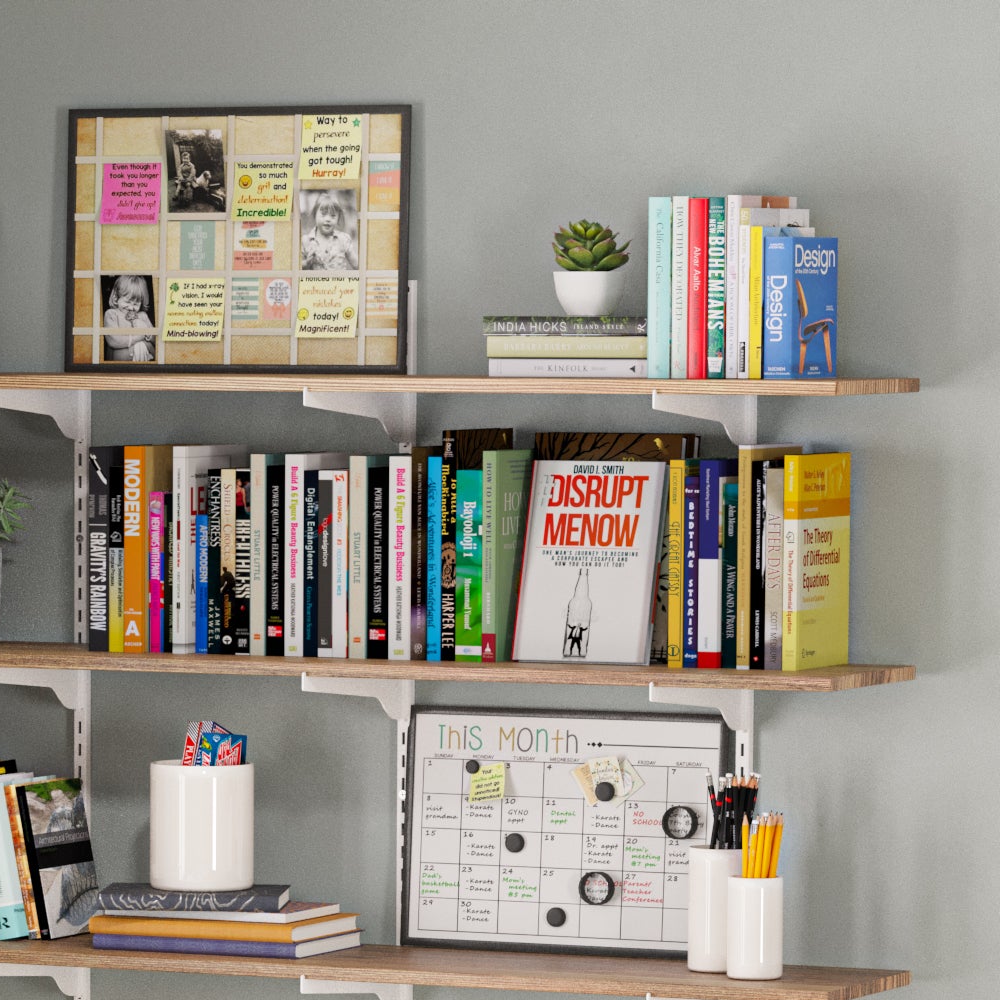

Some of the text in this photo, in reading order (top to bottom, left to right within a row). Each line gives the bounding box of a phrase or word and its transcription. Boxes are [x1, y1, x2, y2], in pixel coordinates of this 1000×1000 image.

[317, 115, 348, 126] Way to
[313, 130, 350, 143] persevere
[303, 145, 323, 153] when
[340, 145, 361, 153] going
[308, 156, 353, 166] got tough!
[130, 163, 148, 171] though
[312, 169, 346, 178] Hurray!
[257, 182, 271, 194] grit
[236, 208, 287, 217] Incredible!
[708, 218, 716, 234] NEW
[716, 220, 724, 234] THE
[693, 246, 702, 291] Alvar Aalto
[794, 244, 836, 275] Design
[708, 236, 725, 330] BOHEMIANS
[313, 312, 339, 321] today!
[766, 275, 788, 342] Design
[167, 330, 219, 338] Mind-blowing!
[299, 325, 350, 333] Magnificent!
[493, 321, 567, 332] INDIA HICKS
[290, 466, 298, 484] Build
[396, 468, 405, 487] Build
[124, 458, 140, 537] MODERN
[547, 474, 649, 508] DISRUPT
[210, 476, 221, 547] ENCHANTRESS
[290, 498, 298, 521] Figure
[395, 501, 405, 523] Figure
[290, 522, 298, 547] Beauty
[306, 487, 316, 580] Digital Entanglement
[394, 525, 405, 550] Beauty
[542, 513, 640, 547] MENOW
[803, 528, 833, 546] The Theory
[199, 524, 208, 582] AFRO MODERN
[235, 519, 250, 599] BREATHLESS
[253, 529, 261, 581] STUART LITTLE
[290, 548, 298, 578] Business
[353, 532, 361, 584] STUART LITTLE
[767, 514, 781, 590] AFTER DAYS
[803, 548, 841, 567] of Differential
[396, 551, 405, 582] Business
[687, 502, 696, 645] BEDTIME STORIES
[90, 532, 106, 631] GRAVITY'S RAINBOW
[802, 572, 830, 592] Equations
[125, 620, 140, 636] A
[442, 593, 455, 649] HARPER LEE
[769, 611, 778, 664] SCOTT MEDBURY
